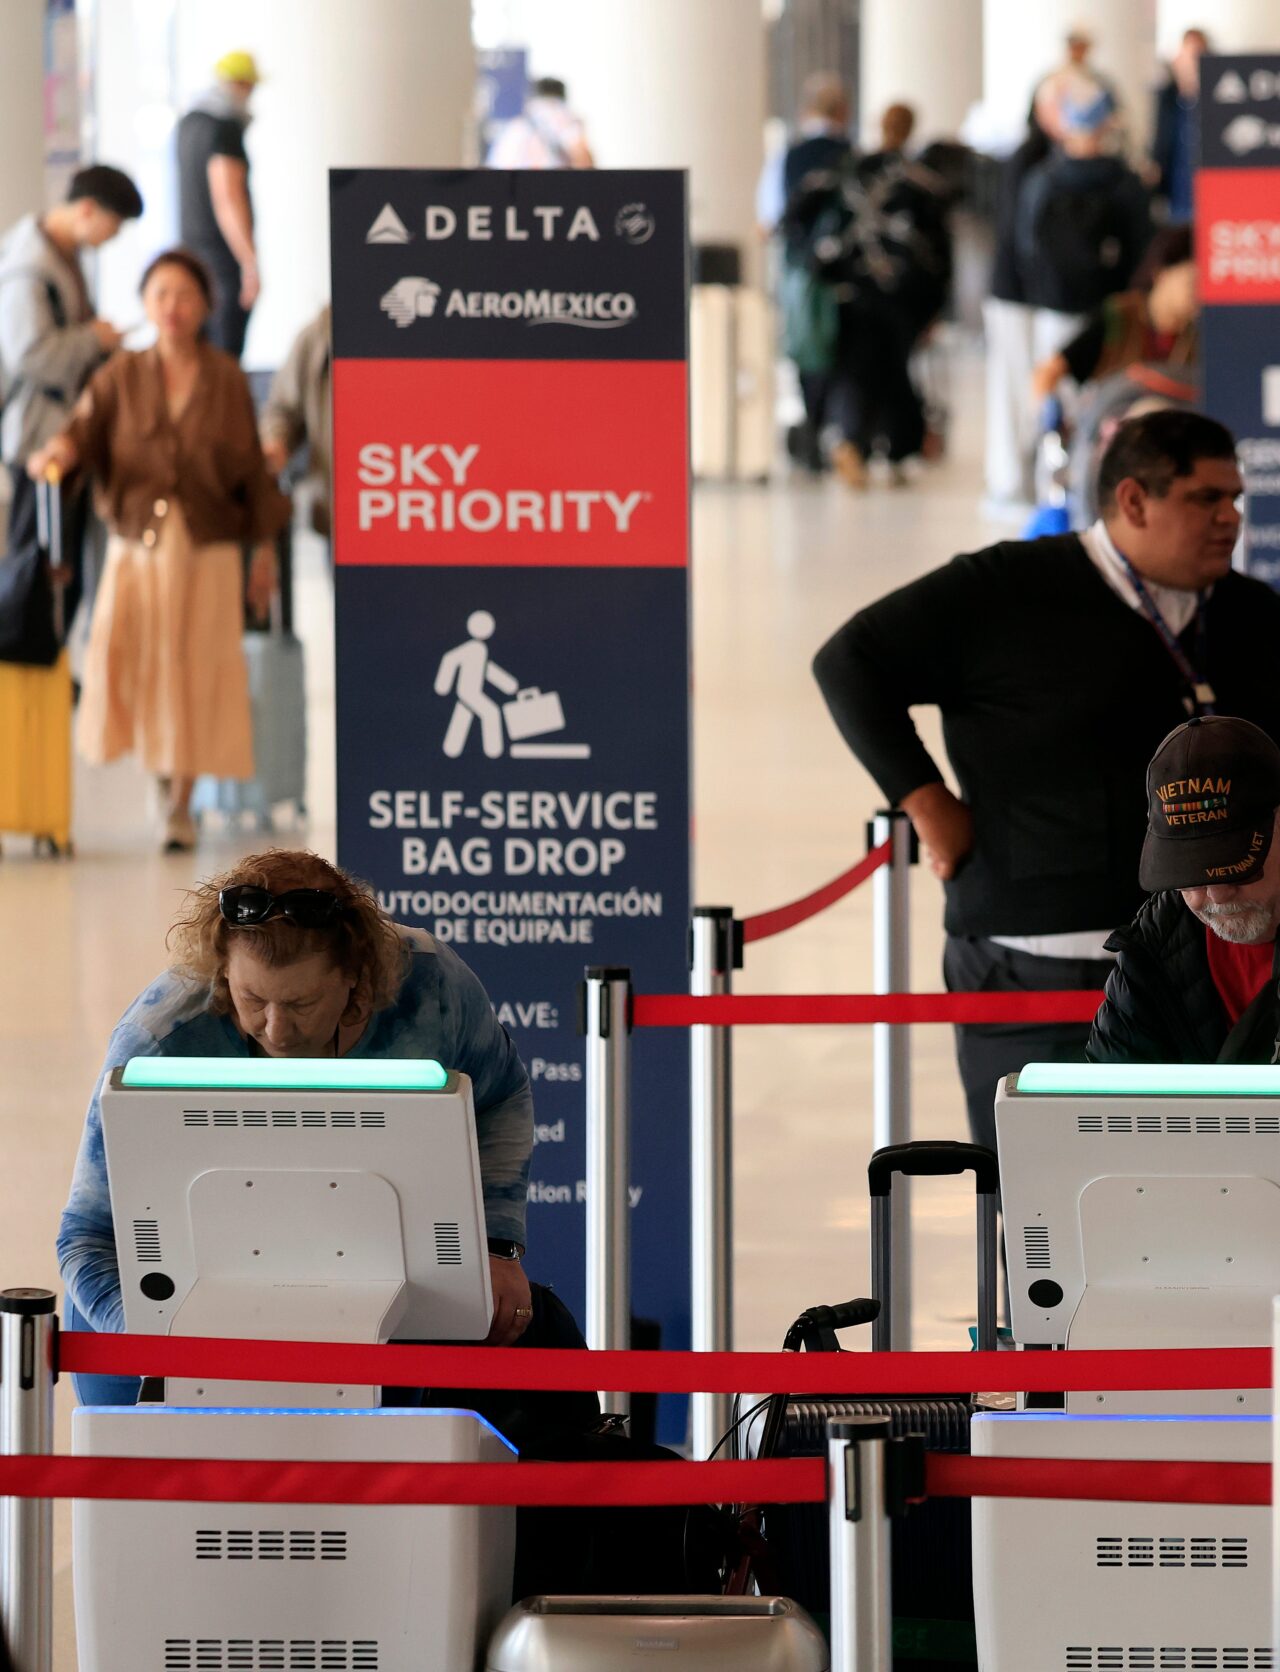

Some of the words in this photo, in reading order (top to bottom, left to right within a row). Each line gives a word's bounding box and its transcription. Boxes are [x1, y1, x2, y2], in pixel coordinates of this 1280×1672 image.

[426, 206, 600, 241] DELTA
[358, 443, 480, 486] SKY
[358, 490, 642, 533] PRIORITY
[1156, 777, 1231, 801] VIETNAM
[368, 791, 658, 831] SELF-SERVICE
[1166, 809, 1228, 826] VETERAN
[402, 838, 493, 876] BAG
[505, 838, 626, 876] DROP
[1206, 854, 1256, 878] VIETNAM
[1250, 831, 1264, 853] VET
[435, 918, 469, 943] DE
[474, 918, 593, 946] EQUIPAJE
[492, 1002, 559, 1028] AVE:
[531, 1058, 582, 1081] Pass
[527, 1180, 571, 1204] tion
